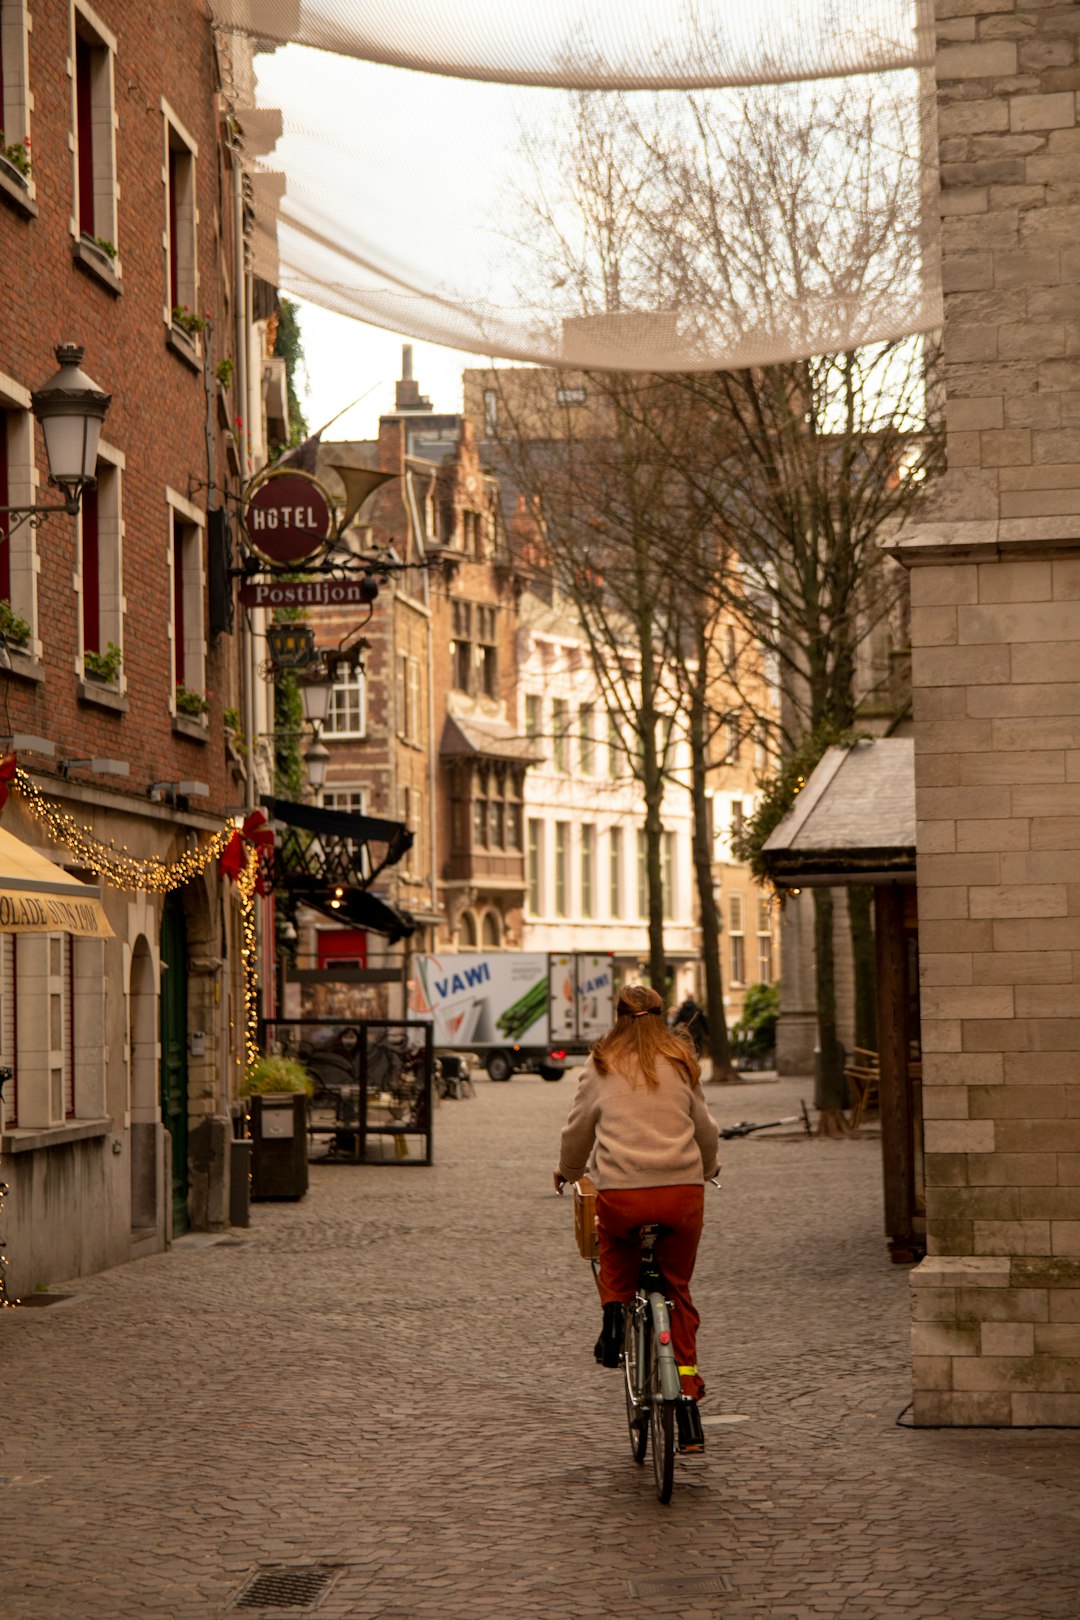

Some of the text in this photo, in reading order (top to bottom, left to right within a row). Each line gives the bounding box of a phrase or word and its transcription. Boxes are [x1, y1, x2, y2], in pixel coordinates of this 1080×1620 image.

[253, 507, 317, 530] HOTEL
[256, 584, 361, 604] Postiljon
[76, 905, 98, 930] 1908
[434, 962, 491, 998] VAWI
